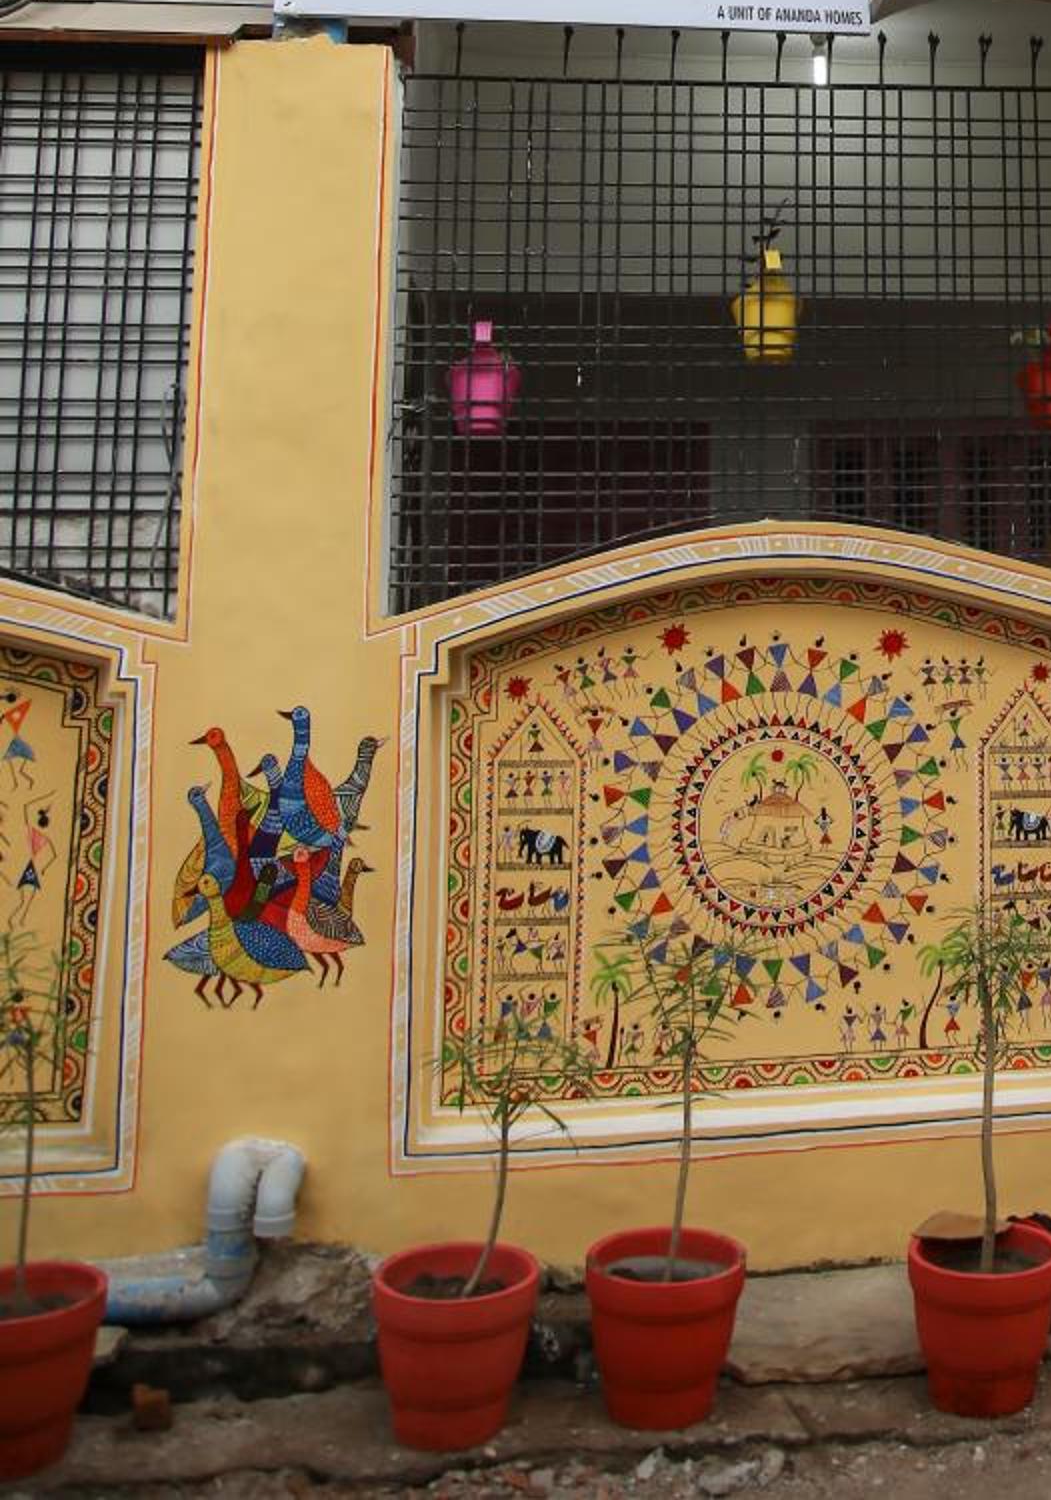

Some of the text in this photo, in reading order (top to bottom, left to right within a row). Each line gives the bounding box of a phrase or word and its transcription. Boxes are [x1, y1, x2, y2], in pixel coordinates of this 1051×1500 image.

[717, 5, 863, 25] A UNIT OF ANANDA HOMES
